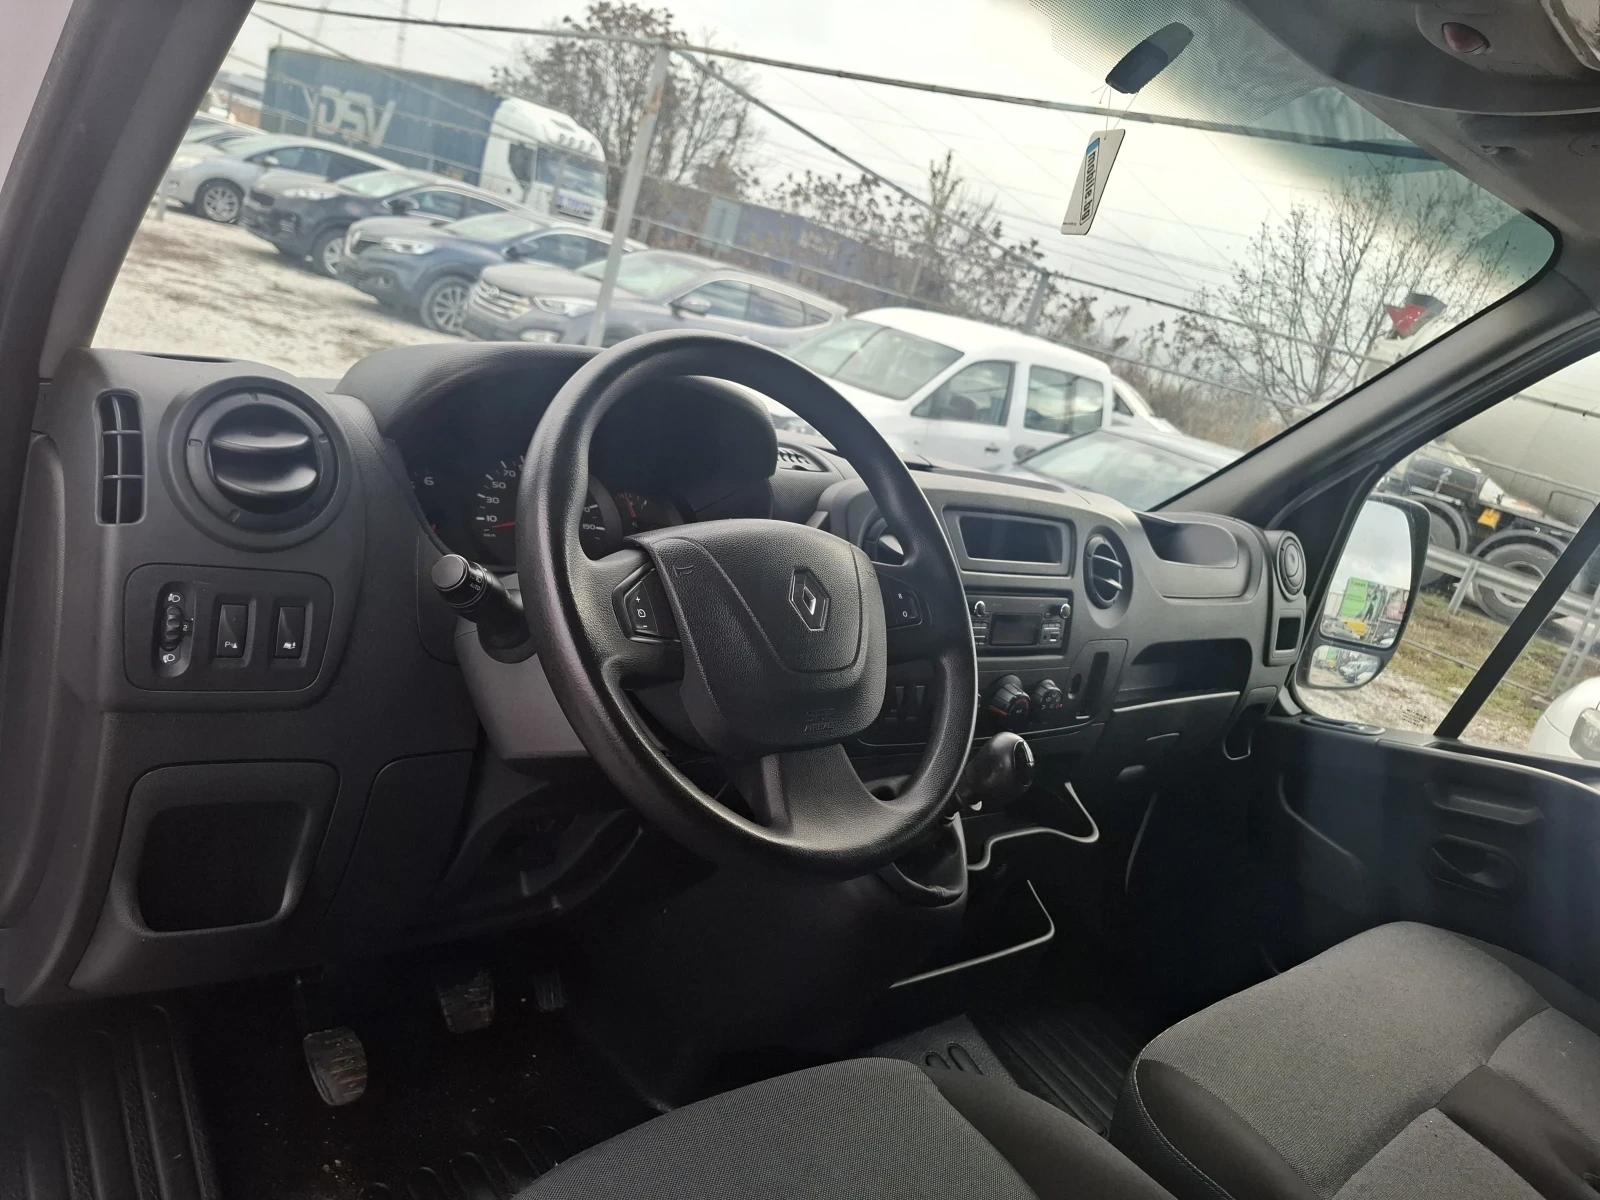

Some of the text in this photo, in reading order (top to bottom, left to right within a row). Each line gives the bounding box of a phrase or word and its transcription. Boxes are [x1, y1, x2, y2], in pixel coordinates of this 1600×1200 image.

[318, 84, 397, 149] DSV
[1081, 150, 1096, 221] mobile.bg
[503, 469, 516, 478] 70
[424, 476, 434, 486] 6
[492, 481, 506, 489] 50
[486, 496, 500, 504] 30
[486, 515, 498, 523] 10
[582, 523, 596, 531] 190
